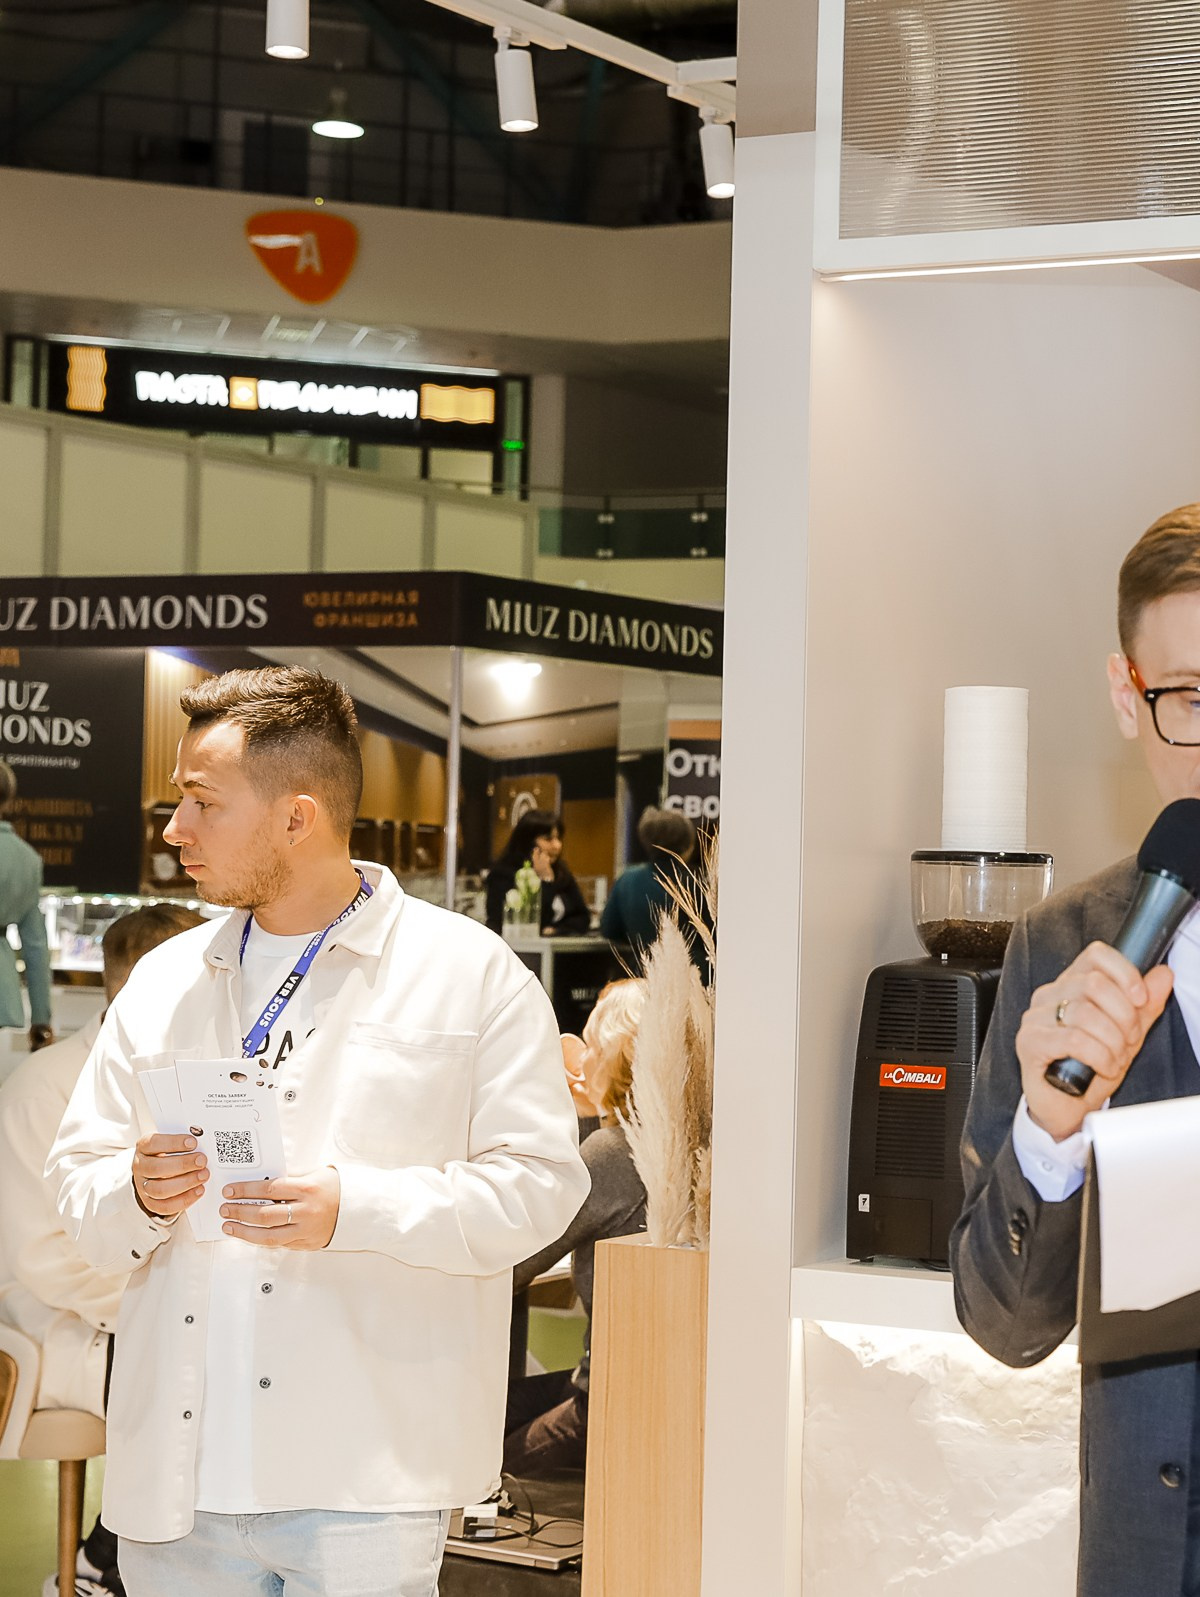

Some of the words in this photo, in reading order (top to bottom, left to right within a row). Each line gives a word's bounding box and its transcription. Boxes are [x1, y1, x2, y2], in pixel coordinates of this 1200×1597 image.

[50, 594, 268, 630] DIAMONDS
[486, 598, 560, 640] MIUZ
[568, 609, 714, 659] DIAMONDS
[0, 713, 92, 748] ONDS
